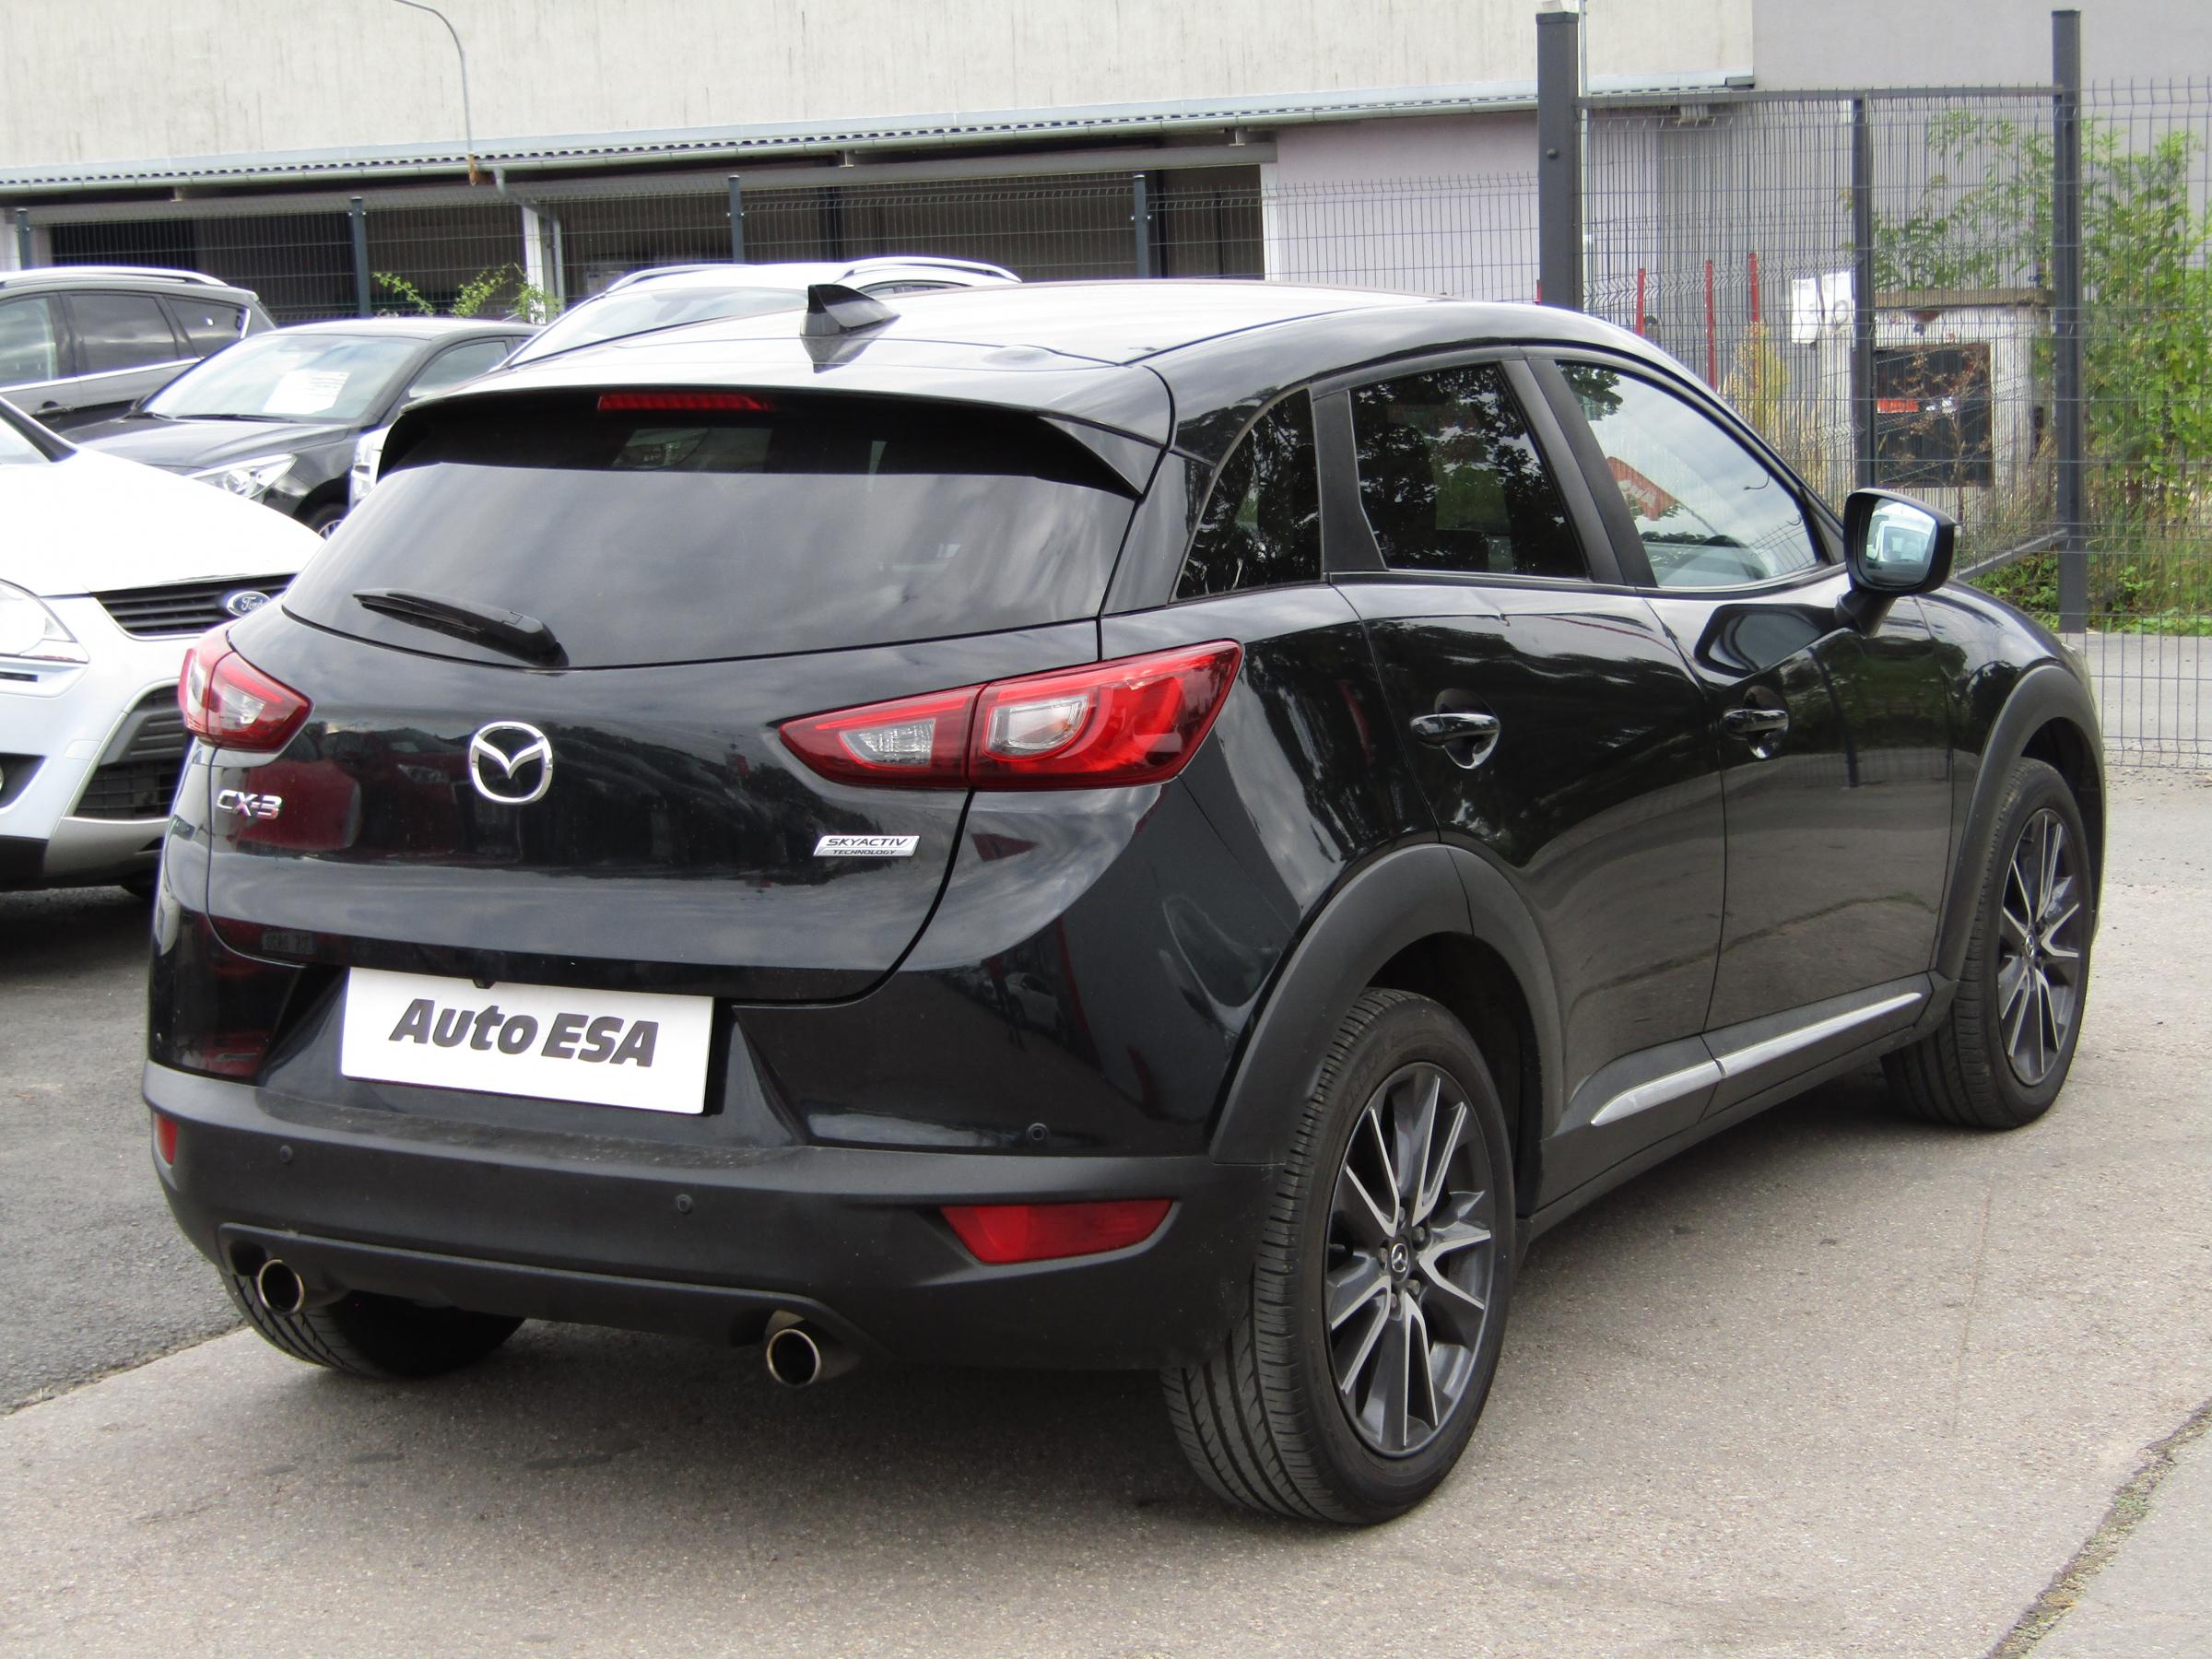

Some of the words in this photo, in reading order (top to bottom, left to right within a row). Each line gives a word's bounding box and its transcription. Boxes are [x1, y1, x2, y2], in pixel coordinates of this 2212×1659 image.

[217, 789, 282, 819] CX-3
[826, 838, 908, 846] SKYACTIV
[389, 998, 538, 1055] Auto
[541, 1012, 659, 1068] ESA
